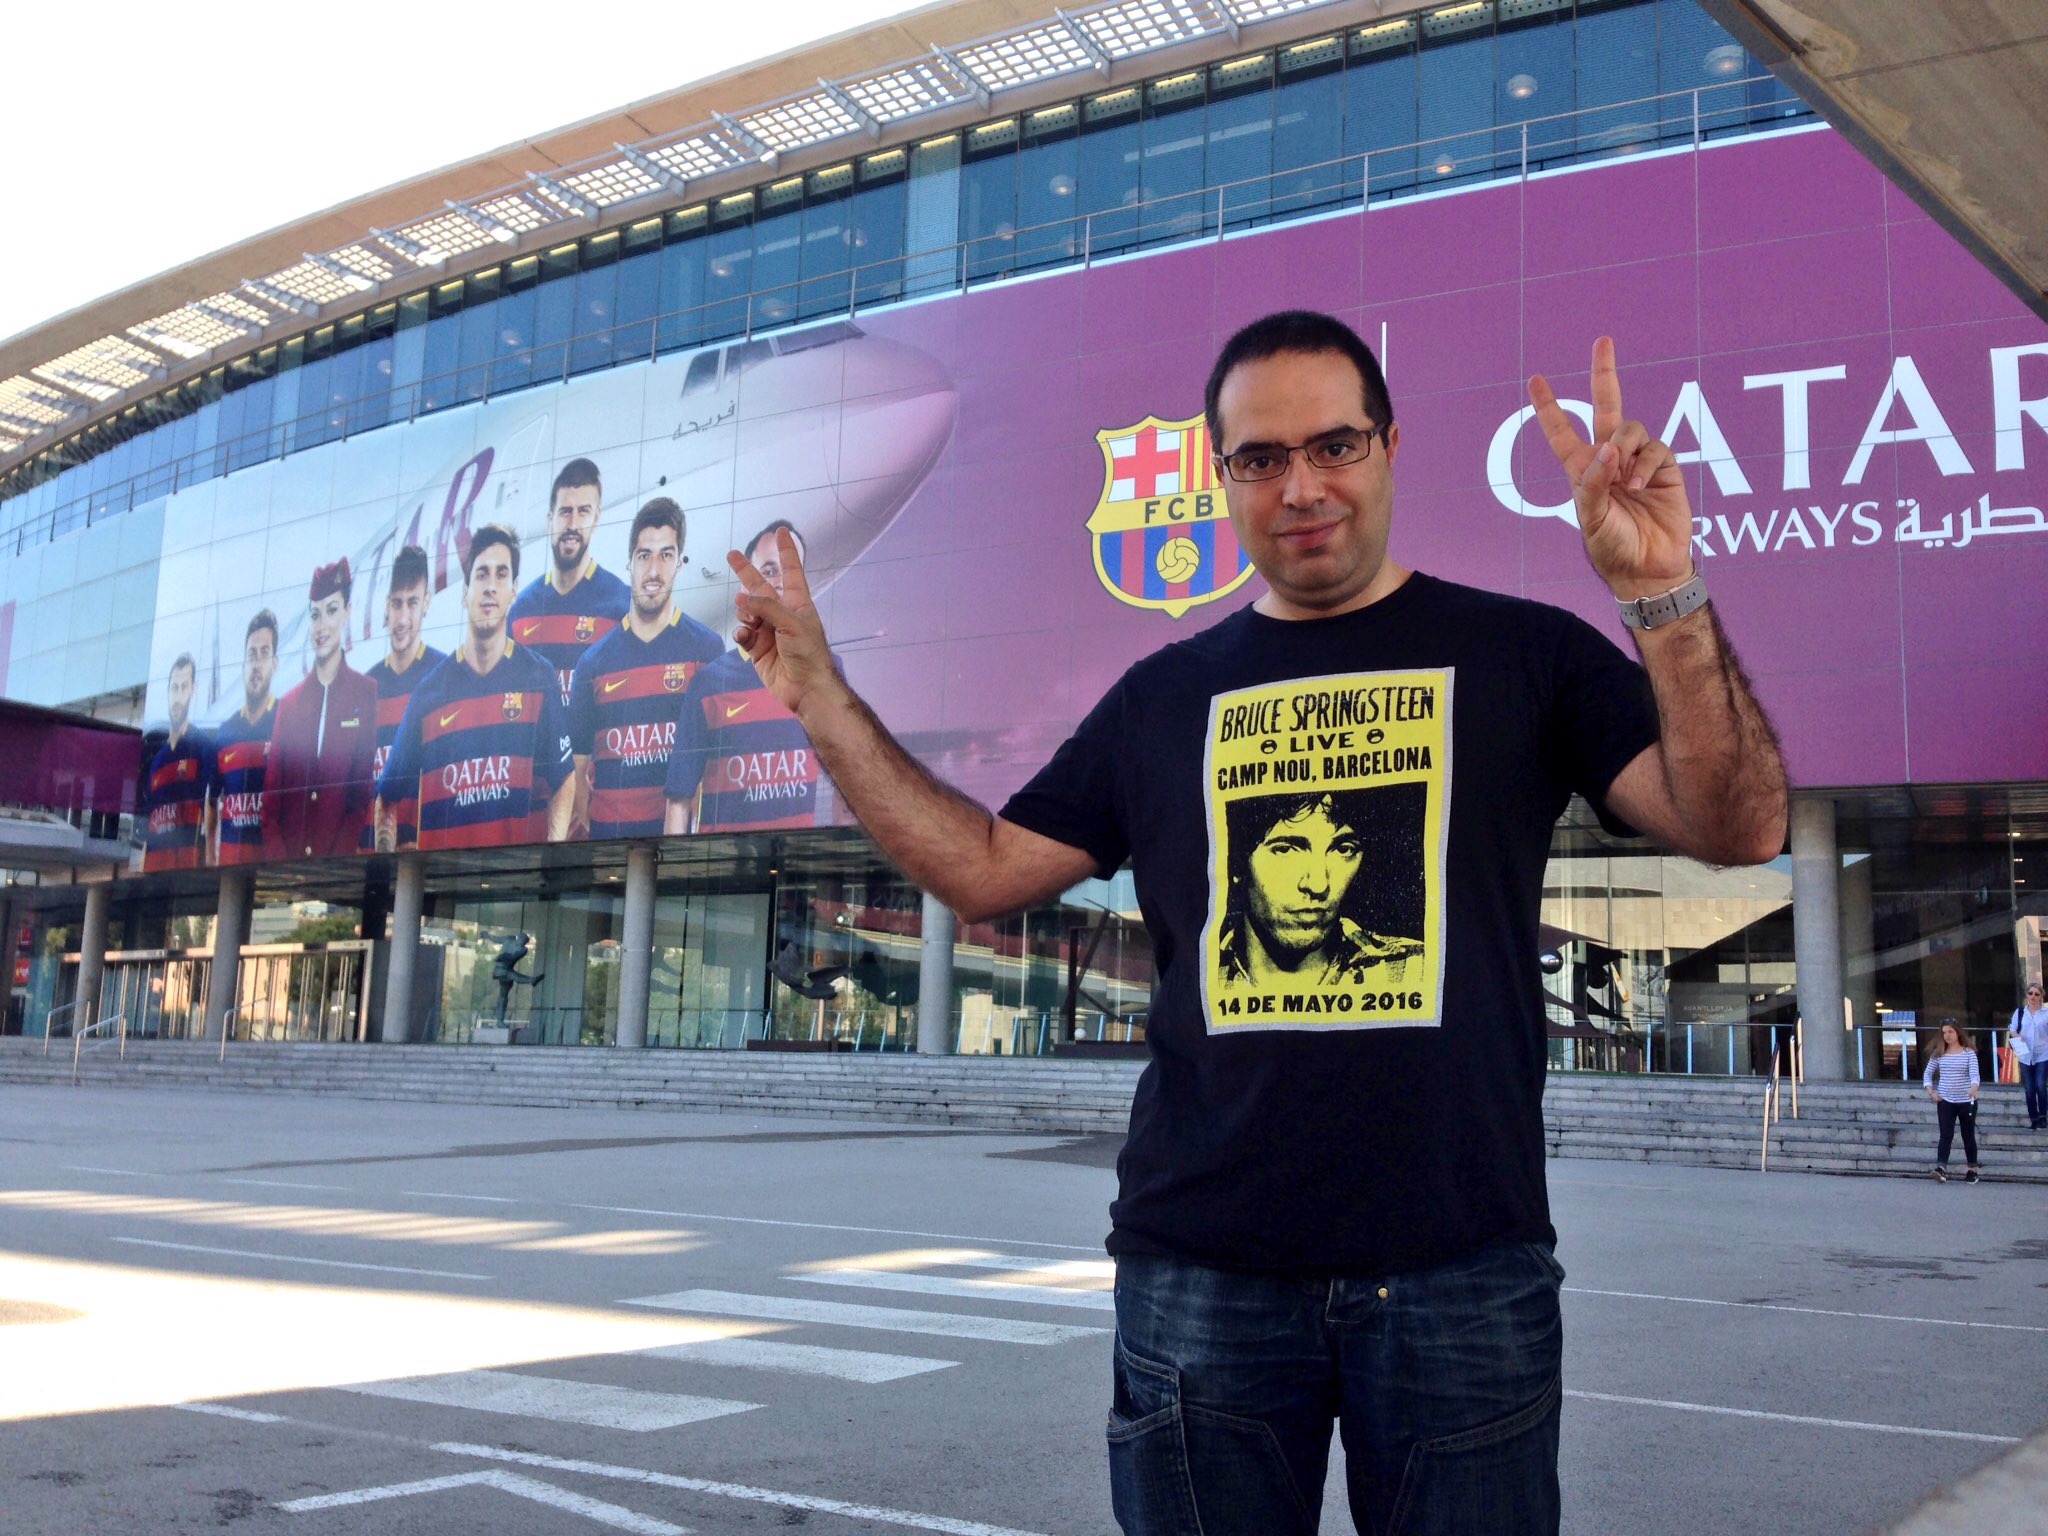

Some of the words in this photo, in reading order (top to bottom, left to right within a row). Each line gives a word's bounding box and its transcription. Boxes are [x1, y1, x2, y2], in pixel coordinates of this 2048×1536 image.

[1145, 494, 1214, 524] FCB
[1894, 492, 2048, 549] طرية
[1690, 501, 1883, 557] RWAYS
[1220, 698, 1284, 743] BRUCE
[1289, 686, 1434, 732] SPRINGSTEEN
[606, 722, 676, 755] QATAR
[1290, 731, 1354, 753] LIVE
[621, 747, 673, 767] AIRWAY
[727, 749, 807, 787] QATAR
[1217, 761, 1268, 791] CAMP
[1273, 758, 1317, 783] NOU,
[1323, 746, 1433, 780] BARCELONA
[443, 756, 510, 794] QATAR
[744, 780, 808, 802] AIRWAYS
[454, 781, 510, 807] AIRWAYS
[1218, 998, 1241, 1016] 14
[1247, 996, 1275, 1014] DE
[1282, 993, 1353, 1013] MAYO
[1361, 991, 1423, 1011] 2016
